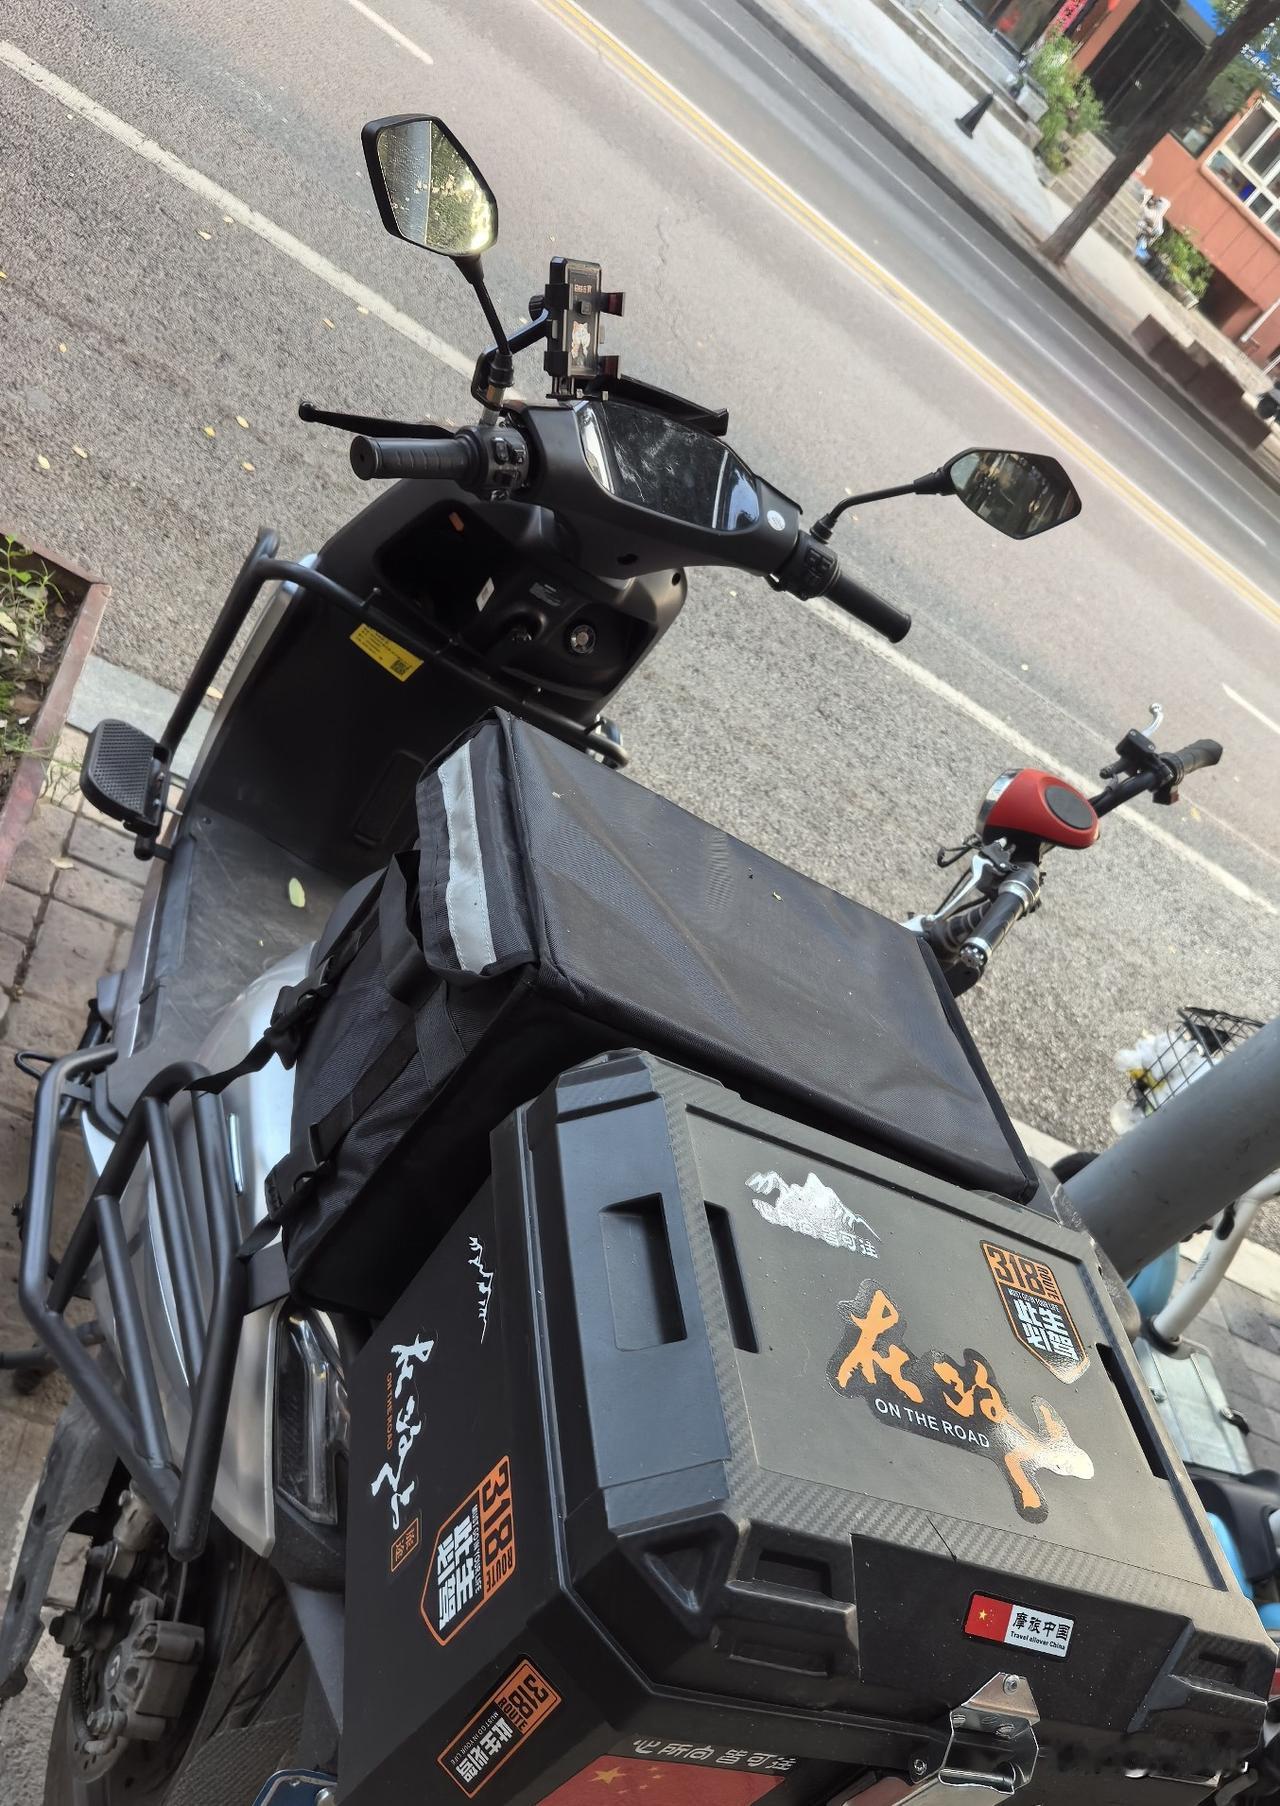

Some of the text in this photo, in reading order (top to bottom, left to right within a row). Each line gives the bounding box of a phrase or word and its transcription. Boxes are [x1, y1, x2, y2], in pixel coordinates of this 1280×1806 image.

[987, 1247, 1046, 1296] 318
[1037, 1265, 1060, 1301] ROUTE
[875, 1398, 990, 1448] ON THE ROAD
[481, 1461, 512, 1566] 318
[473, 1550, 481, 1574] YOUR
[486, 1546, 513, 1593] ROUTE
[474, 1572, 482, 1594] LIFE
[1010, 1631, 1029, 1641] Travel
[1049, 1641, 1065, 1650] China
[498, 1697, 528, 1731] ROUTE
[508, 1674, 549, 1720] 318
[632, 1739, 715, 1761] 心所向
